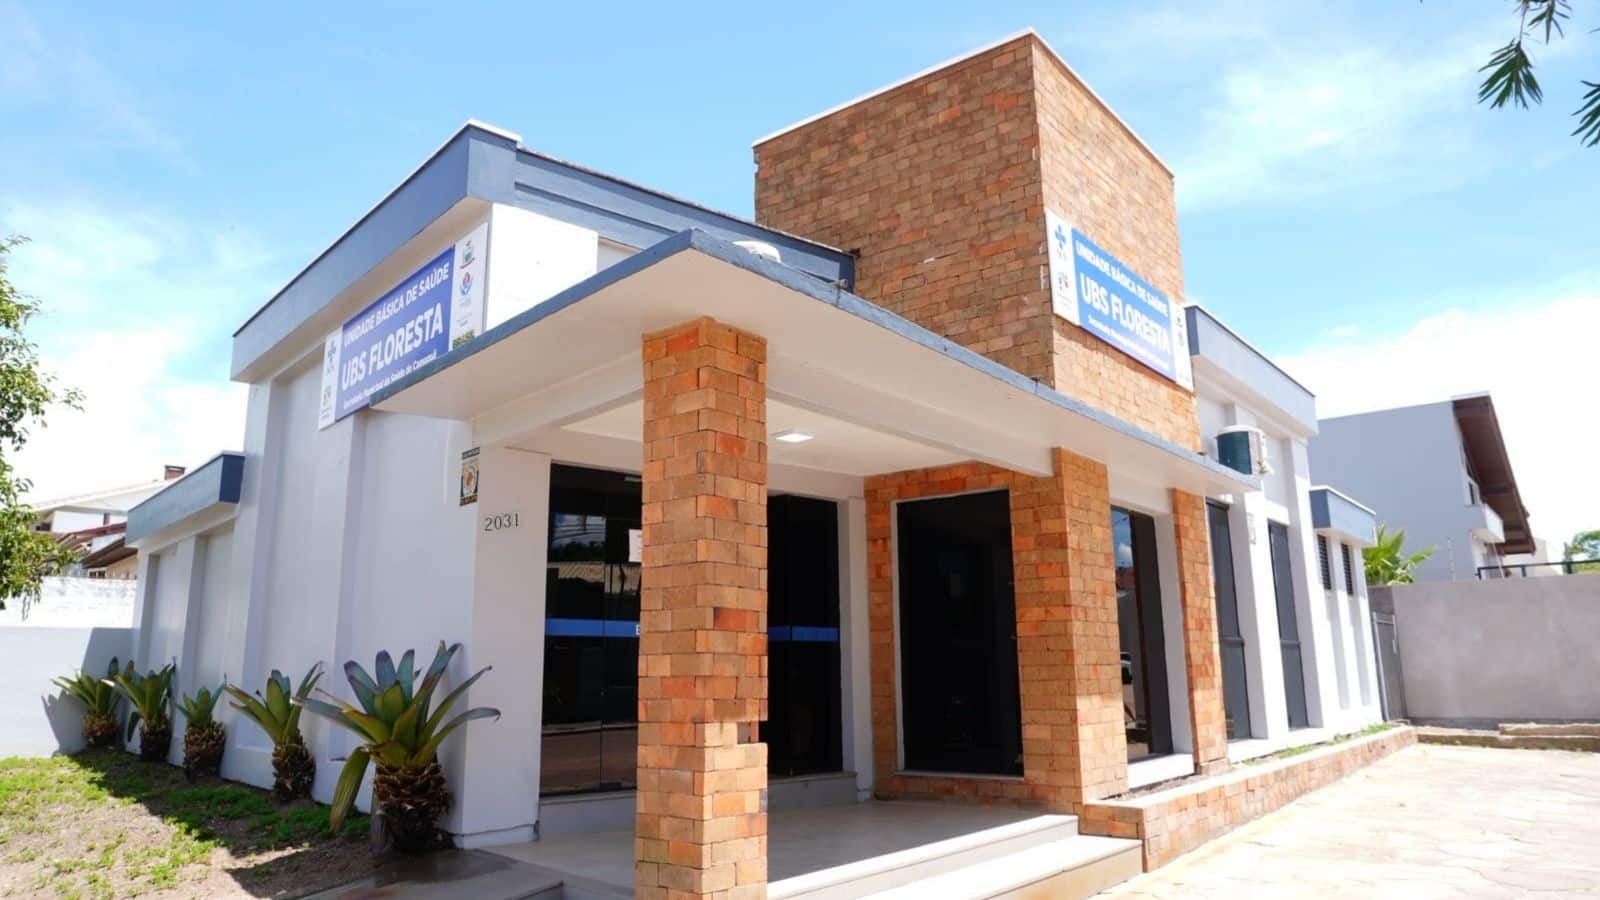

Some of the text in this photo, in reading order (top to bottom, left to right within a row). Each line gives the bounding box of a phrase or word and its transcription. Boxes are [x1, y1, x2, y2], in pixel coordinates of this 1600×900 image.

[344, 263, 449, 346] UNIDADE BÁSICA DE SAÚDE
[1075, 240, 1111, 276] UNIDADE
[1111, 263, 1136, 296] BÁSICA
[1136, 284, 1147, 303] DE
[342, 351, 367, 391] UBS
[369, 303, 443, 376] FLORESTA
[1080, 272, 1110, 316] UBS
[1111, 294, 1169, 353] FLORESTA
[484, 512, 520, 532] 2031
